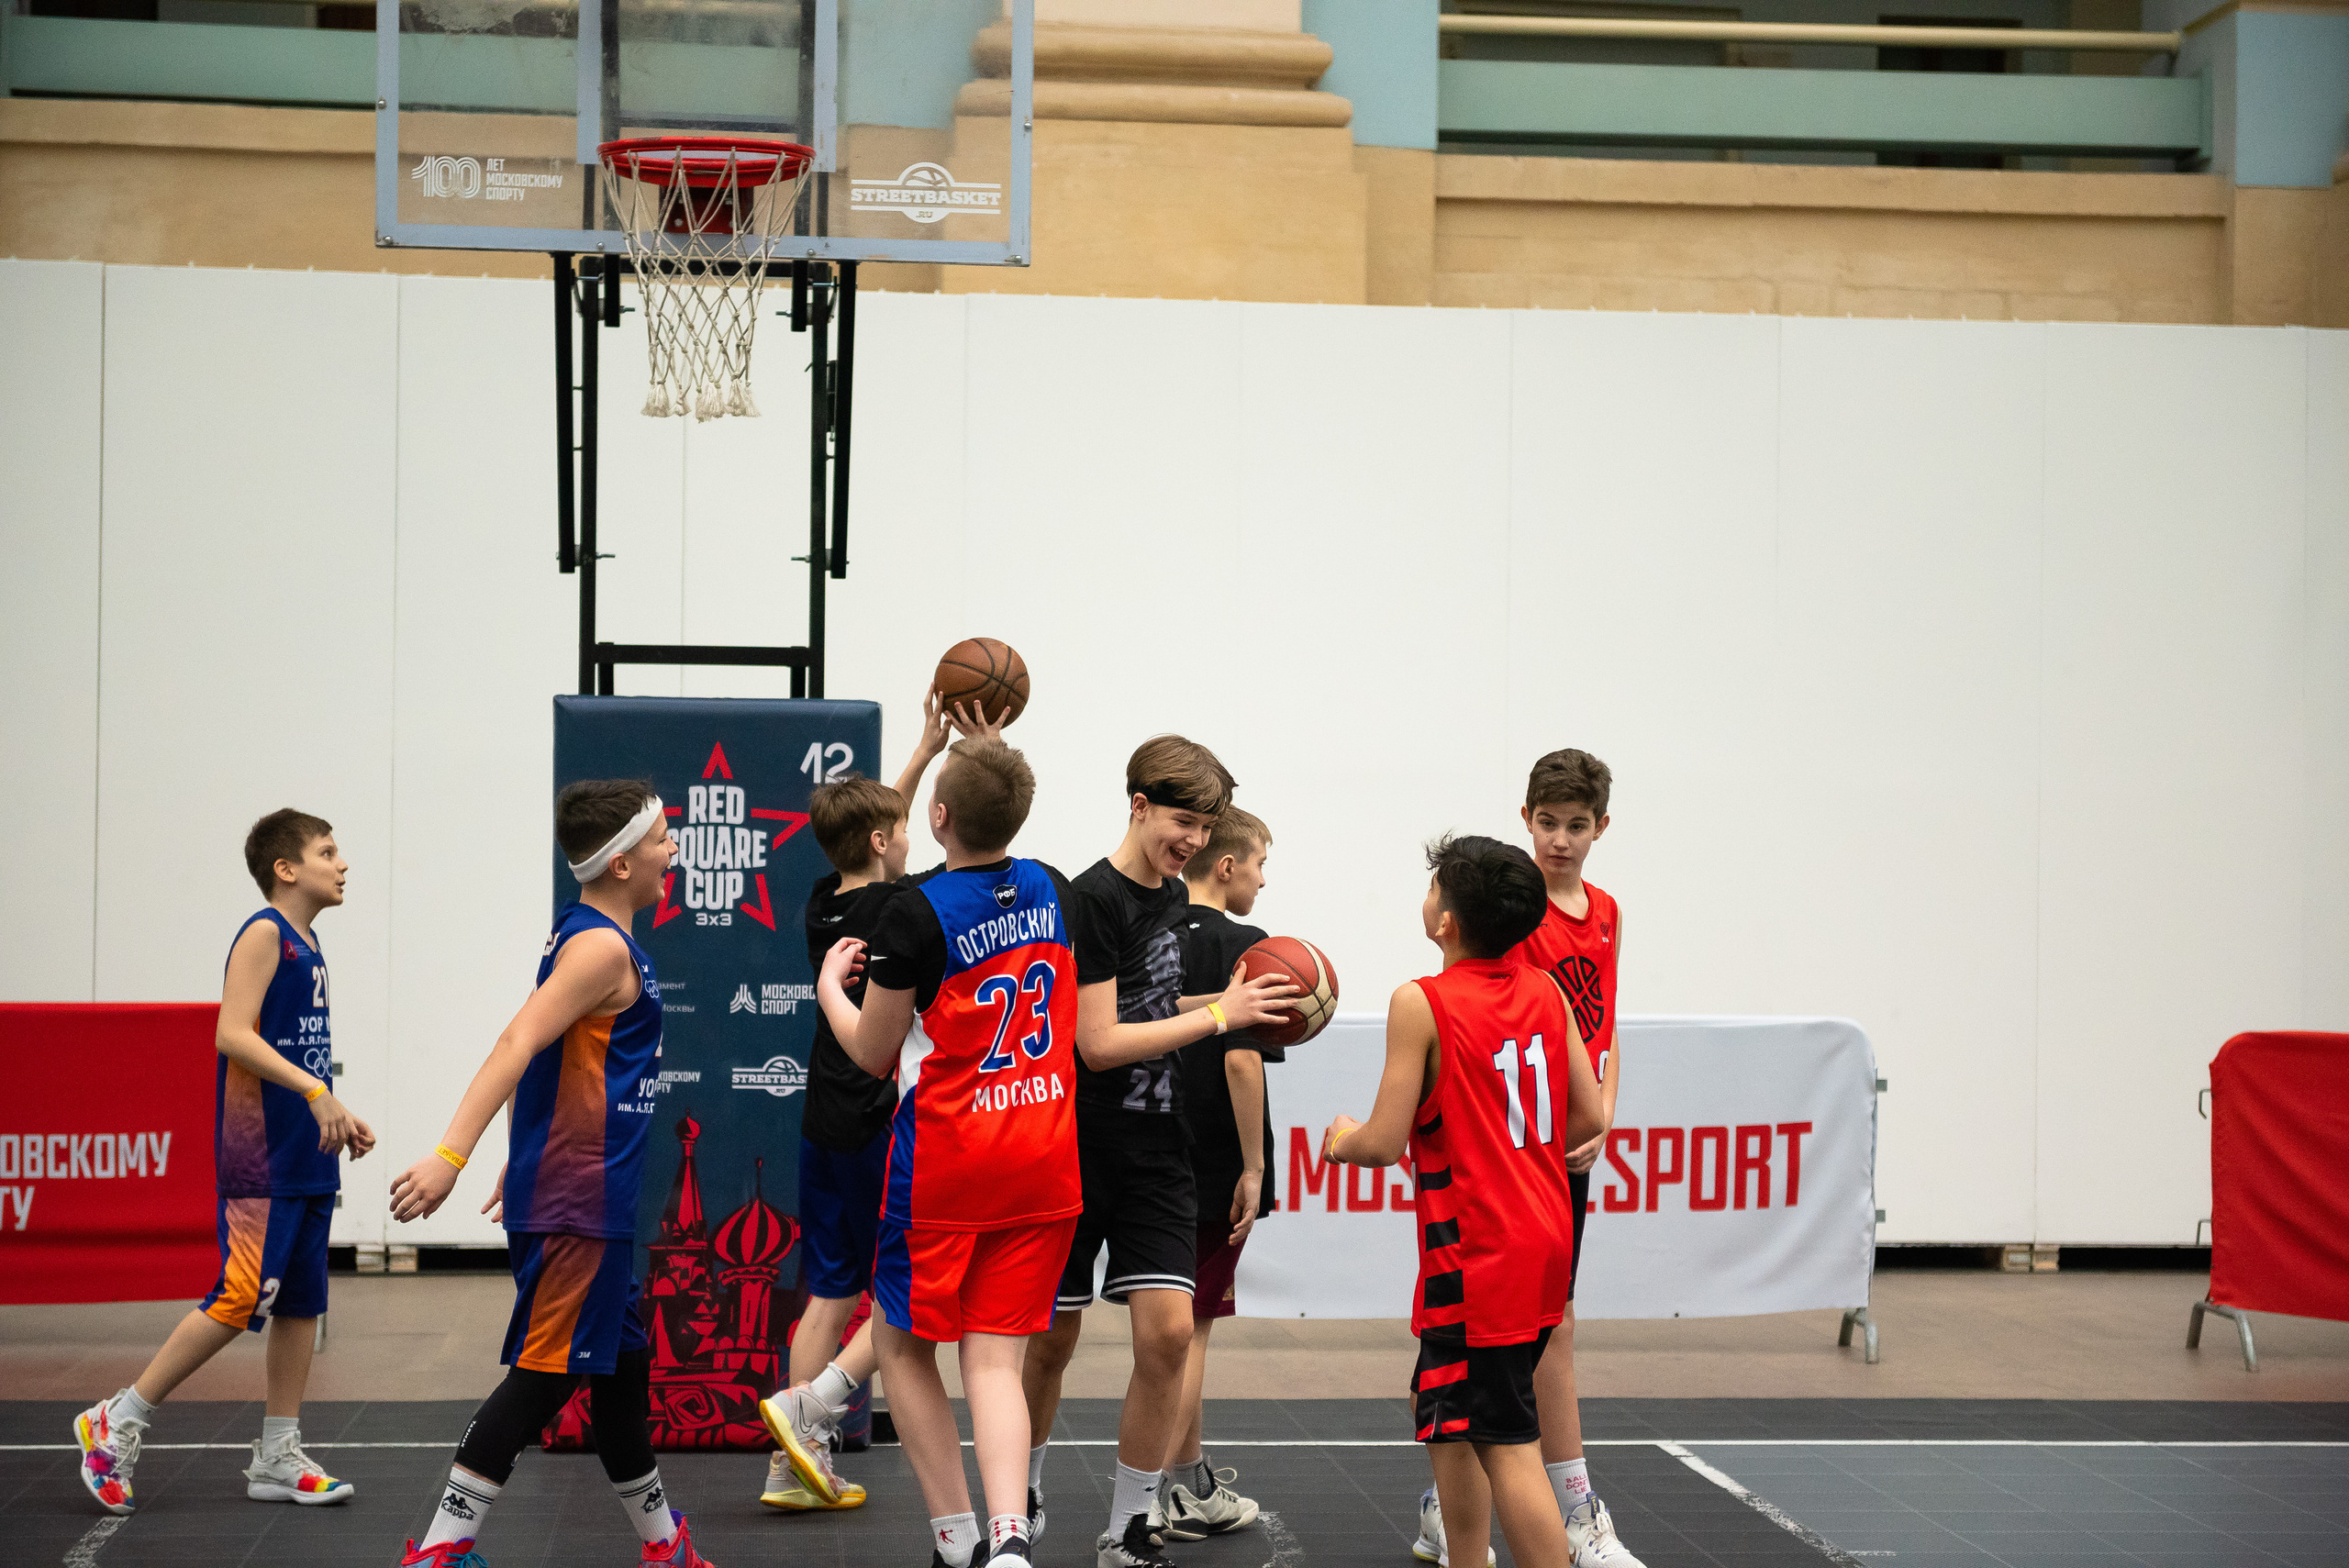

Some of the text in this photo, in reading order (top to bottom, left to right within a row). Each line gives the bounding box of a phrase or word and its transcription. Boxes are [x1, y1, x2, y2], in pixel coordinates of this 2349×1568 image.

[486, 158, 505, 172] ЛЕТ
[412, 156, 481, 199] 100
[486, 172, 562, 188] МОСКОВСКОМУ
[485, 186, 525, 201] СПОРТУ
[851, 188, 1002, 206] STREETBASKET
[800, 742, 854, 784] 12
[688, 784, 745, 825] RED
[685, 868, 743, 910] CUP
[996, 887, 1016, 900] РФБ
[956, 902, 1056, 964] ОСТРОВСКИЙ
[762, 984, 816, 999] МОСКОВС
[761, 1000, 797, 1015] СПОРТ
[974, 959, 1056, 1073] 23
[298, 1016, 323, 1033] УОР
[658, 1071, 700, 1083] КОВСКОМУ
[732, 1074, 807, 1084] STREETBAS
[972, 1073, 1064, 1113] МОСКВА
[1121, 1069, 1173, 1112] 24
[1492, 1032, 1553, 1150] 11
[618, 1103, 635, 1112] им.
[0, 1130, 173, 1179] ОВСКОМУ
